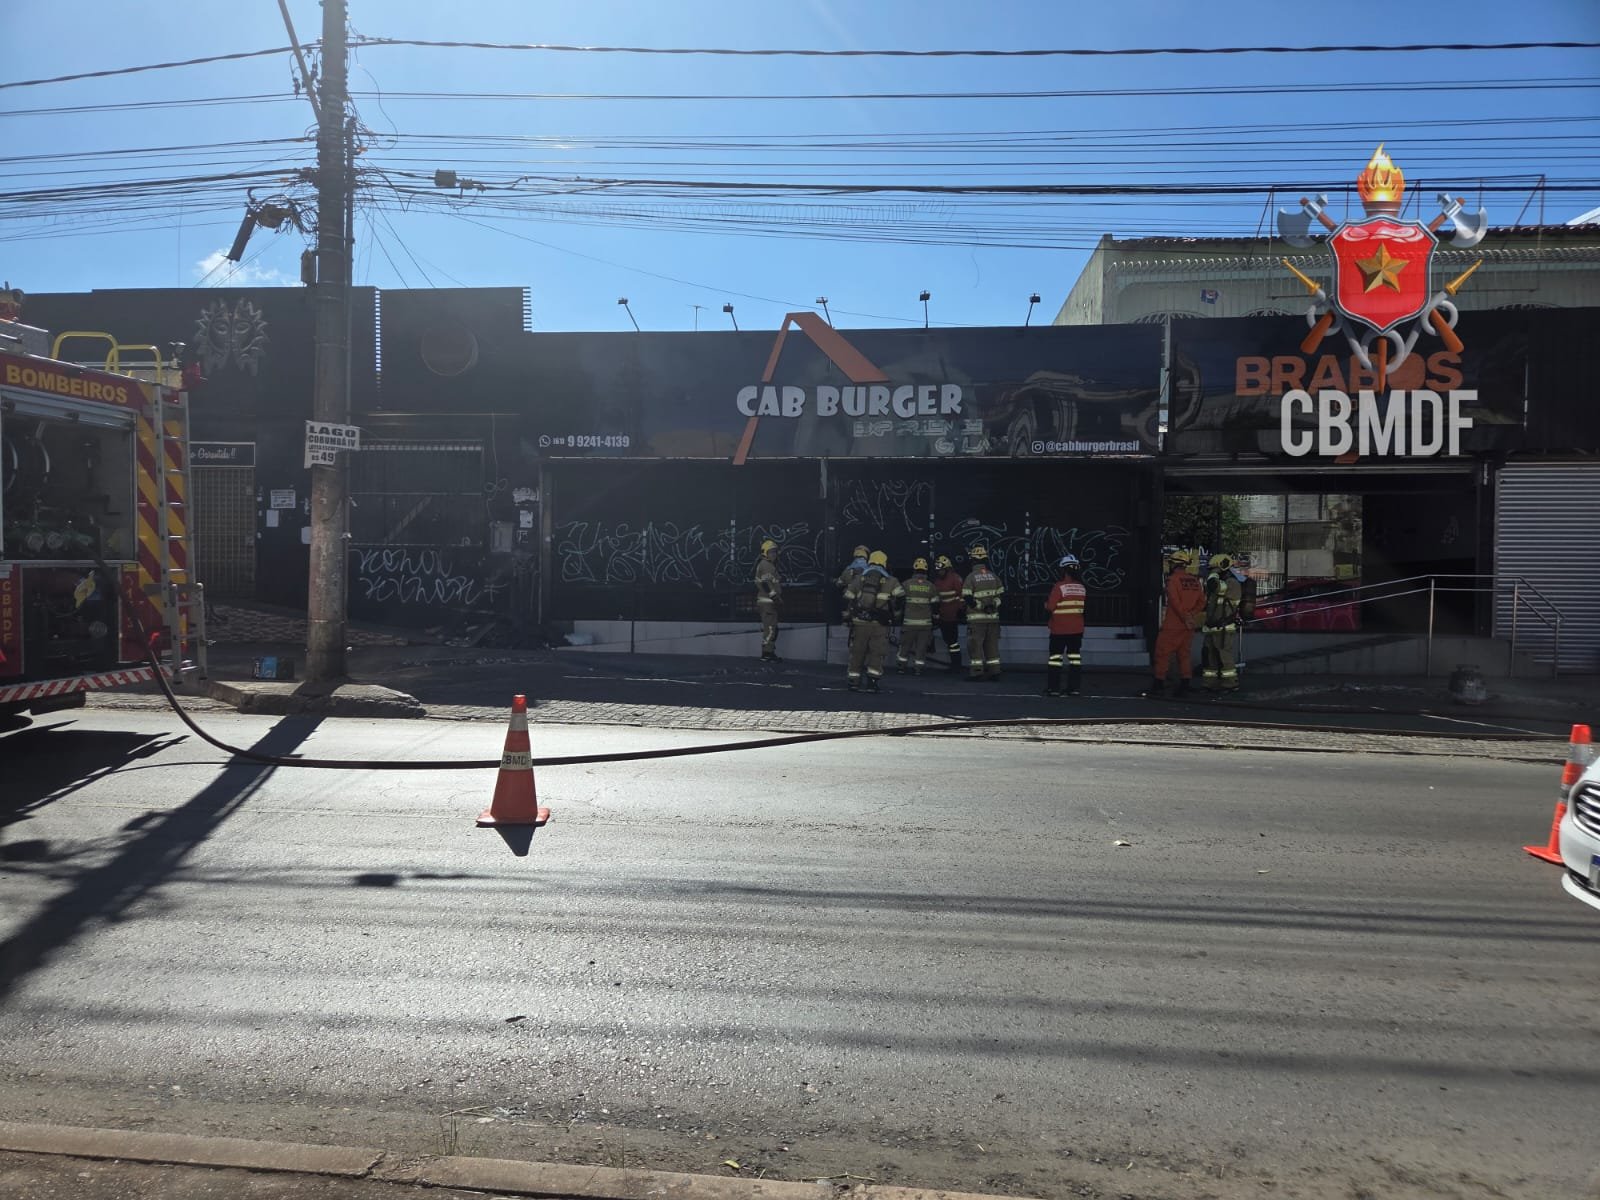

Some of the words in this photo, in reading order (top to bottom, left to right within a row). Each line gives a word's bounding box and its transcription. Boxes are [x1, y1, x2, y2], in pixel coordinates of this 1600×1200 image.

[6, 364, 128, 404] BOMBEIROS
[736, 385, 805, 418] CAB
[816, 384, 963, 418] BURGER
[309, 425, 356, 438] LAGO
[1046, 440, 1140, 453] @cabburgerbrasil
